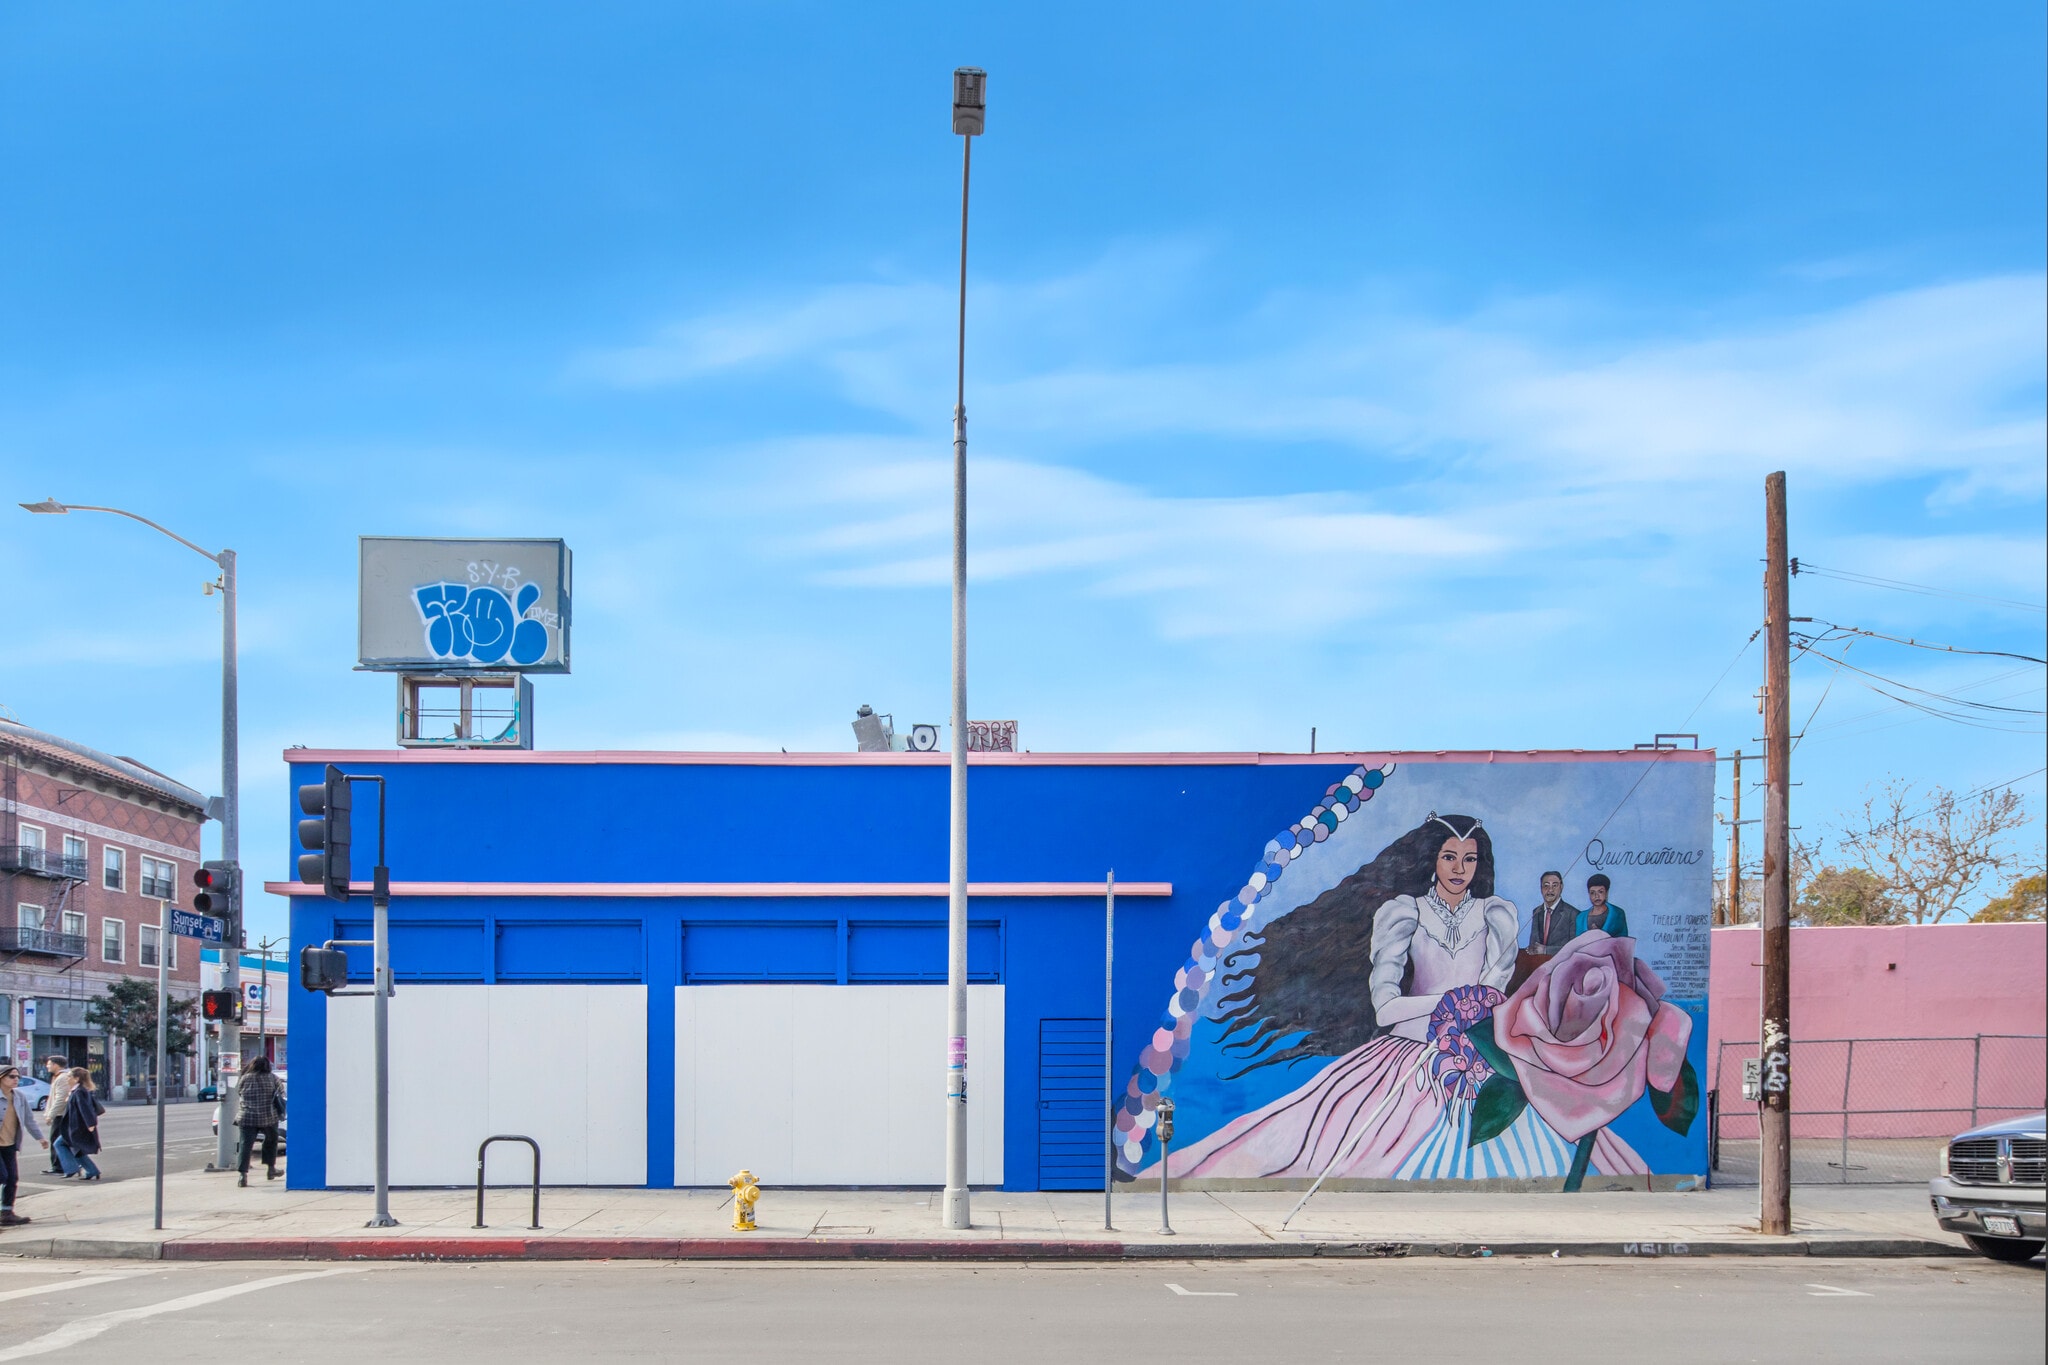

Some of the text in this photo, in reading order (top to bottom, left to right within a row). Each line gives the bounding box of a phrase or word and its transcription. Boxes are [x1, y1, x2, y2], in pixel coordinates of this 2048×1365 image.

[1585, 838, 1704, 871] Quinceañera
[173, 911, 222, 934] Sunset Bl
[1652, 915, 1708, 926] THERESA POWERS
[173, 924, 194, 936] 1700 W
[1653, 932, 1684, 944] CAROLINA
